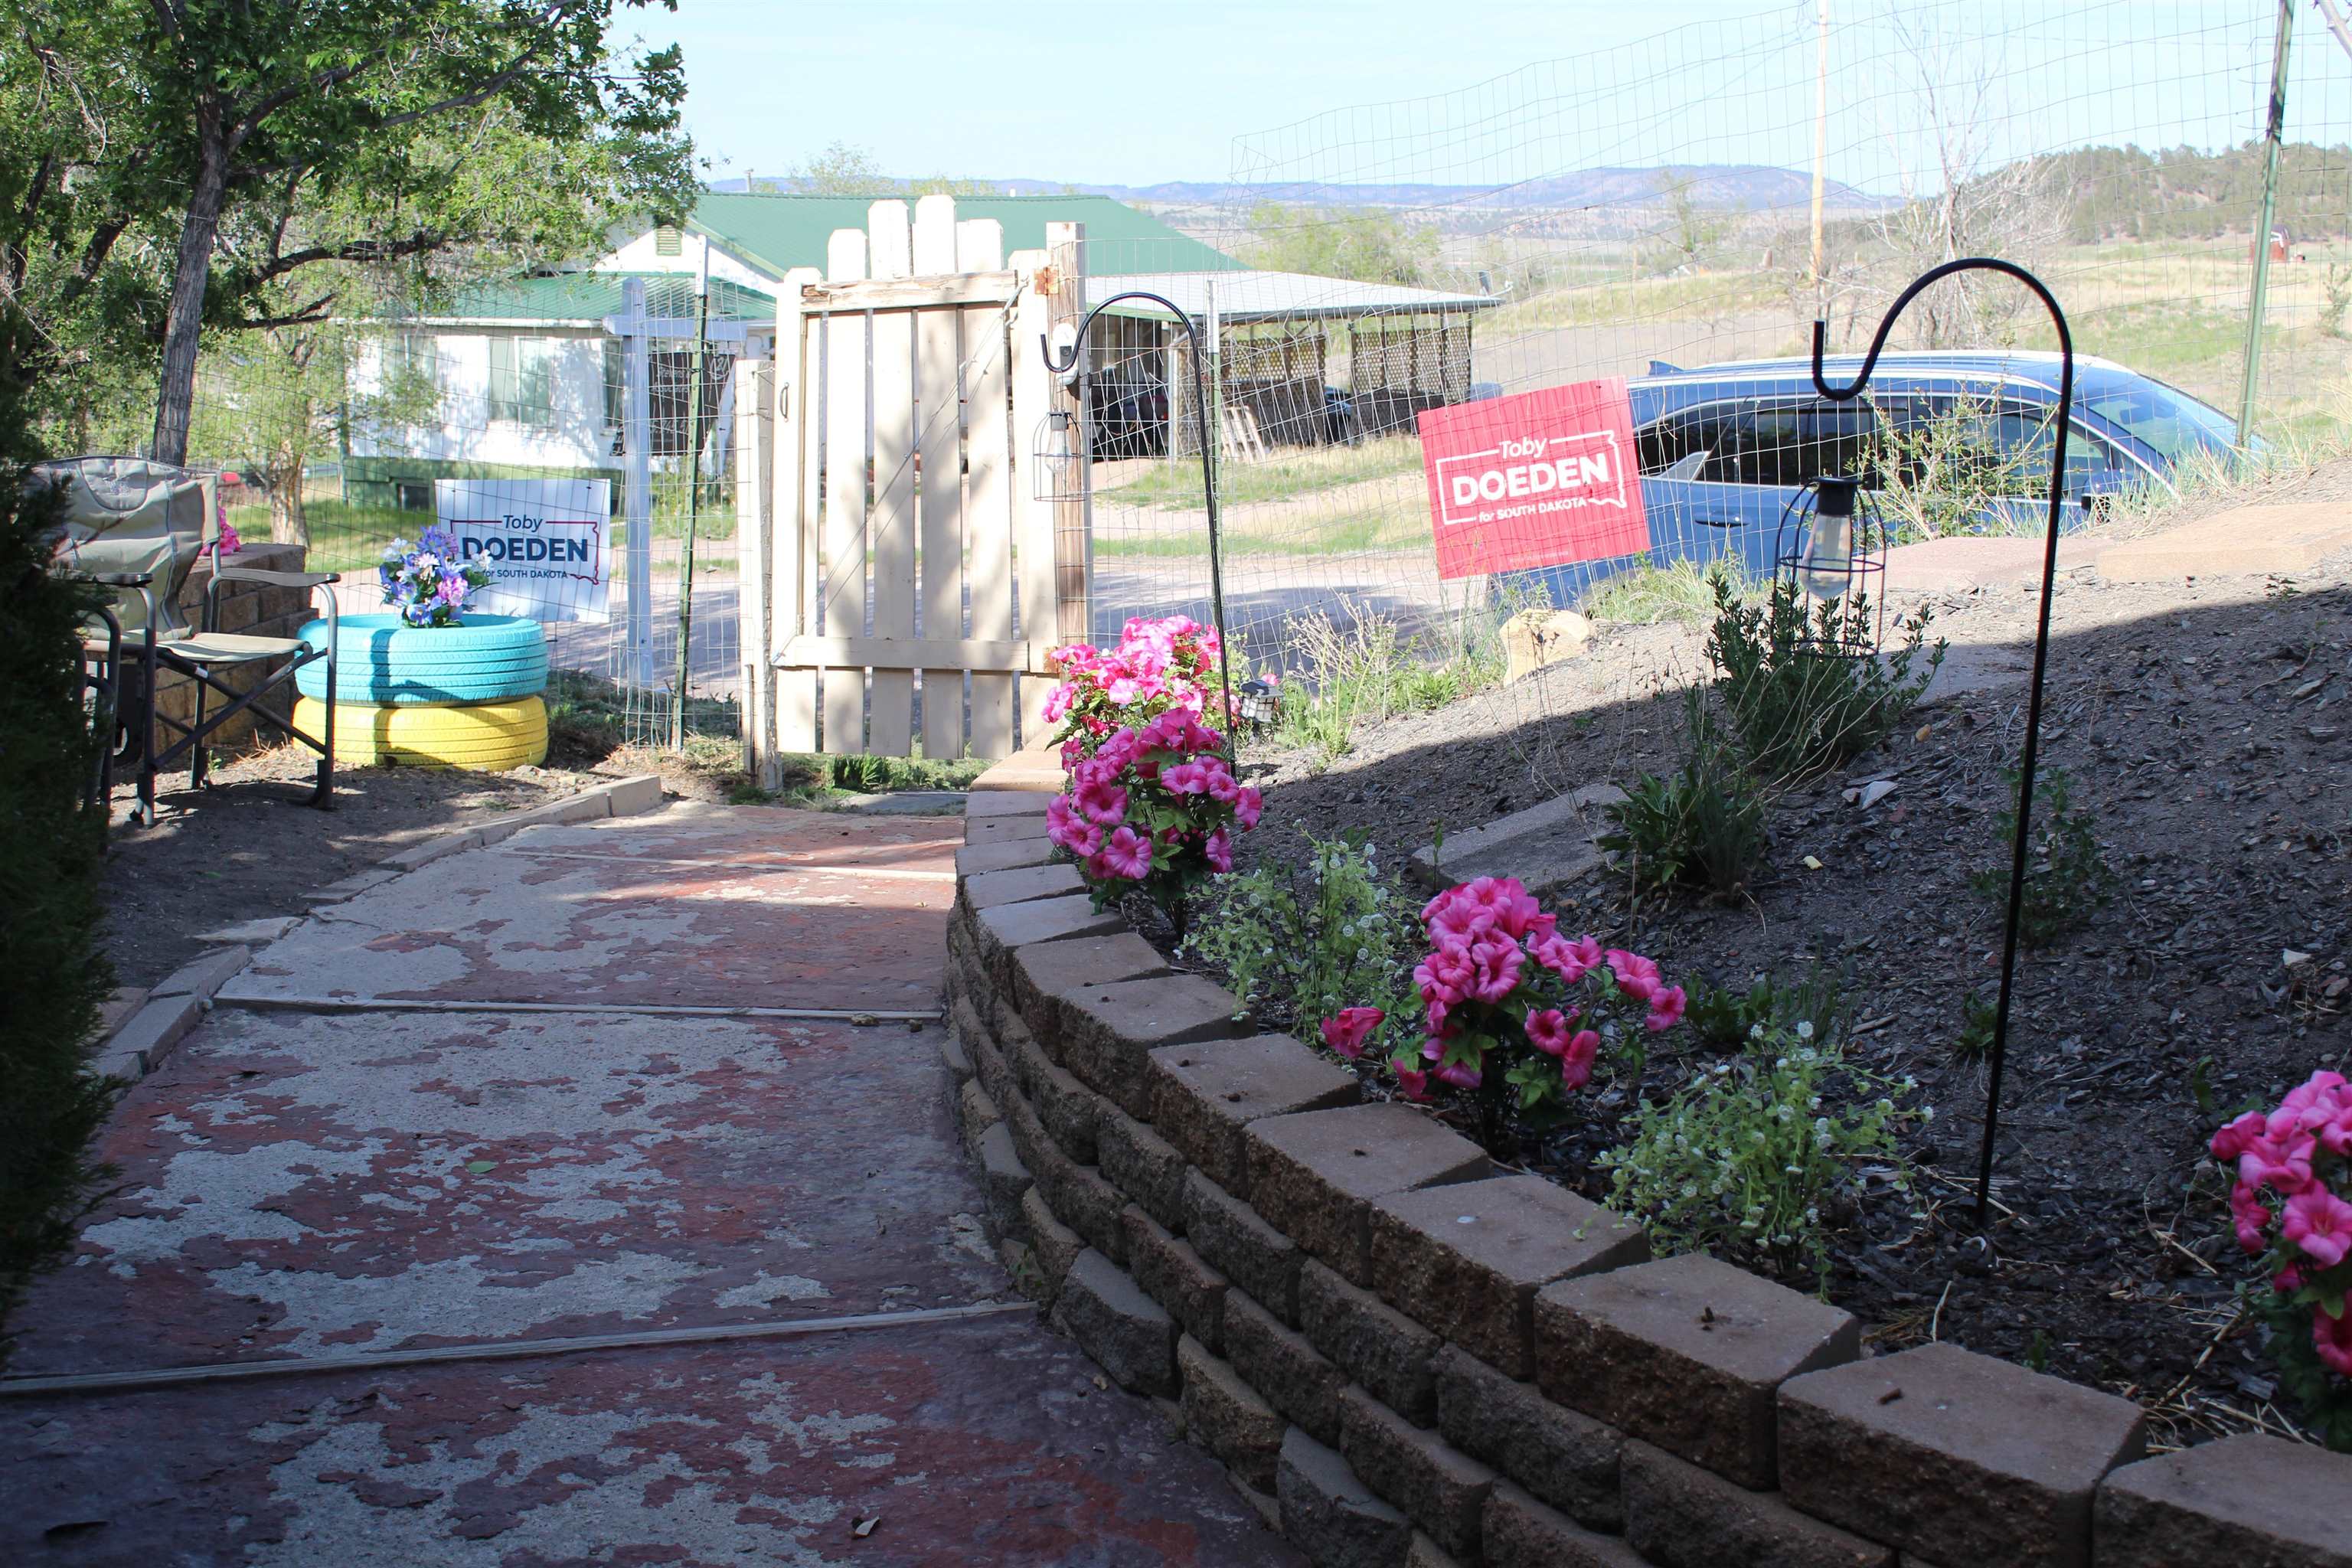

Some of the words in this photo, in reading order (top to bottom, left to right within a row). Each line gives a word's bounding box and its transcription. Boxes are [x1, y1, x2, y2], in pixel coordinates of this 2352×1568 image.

[1500, 437, 1547, 459] Toby
[1452, 452, 1609, 506] DOEDEN
[1478, 511, 1494, 522] for
[1497, 505, 1536, 520] SOUTH
[1538, 497, 1587, 514] DAKOTA
[503, 514, 543, 532] Toby
[462, 537, 588, 561] DOEDEN
[497, 570, 528, 578] SOUTH
[530, 570, 568, 579] DAKOTA
